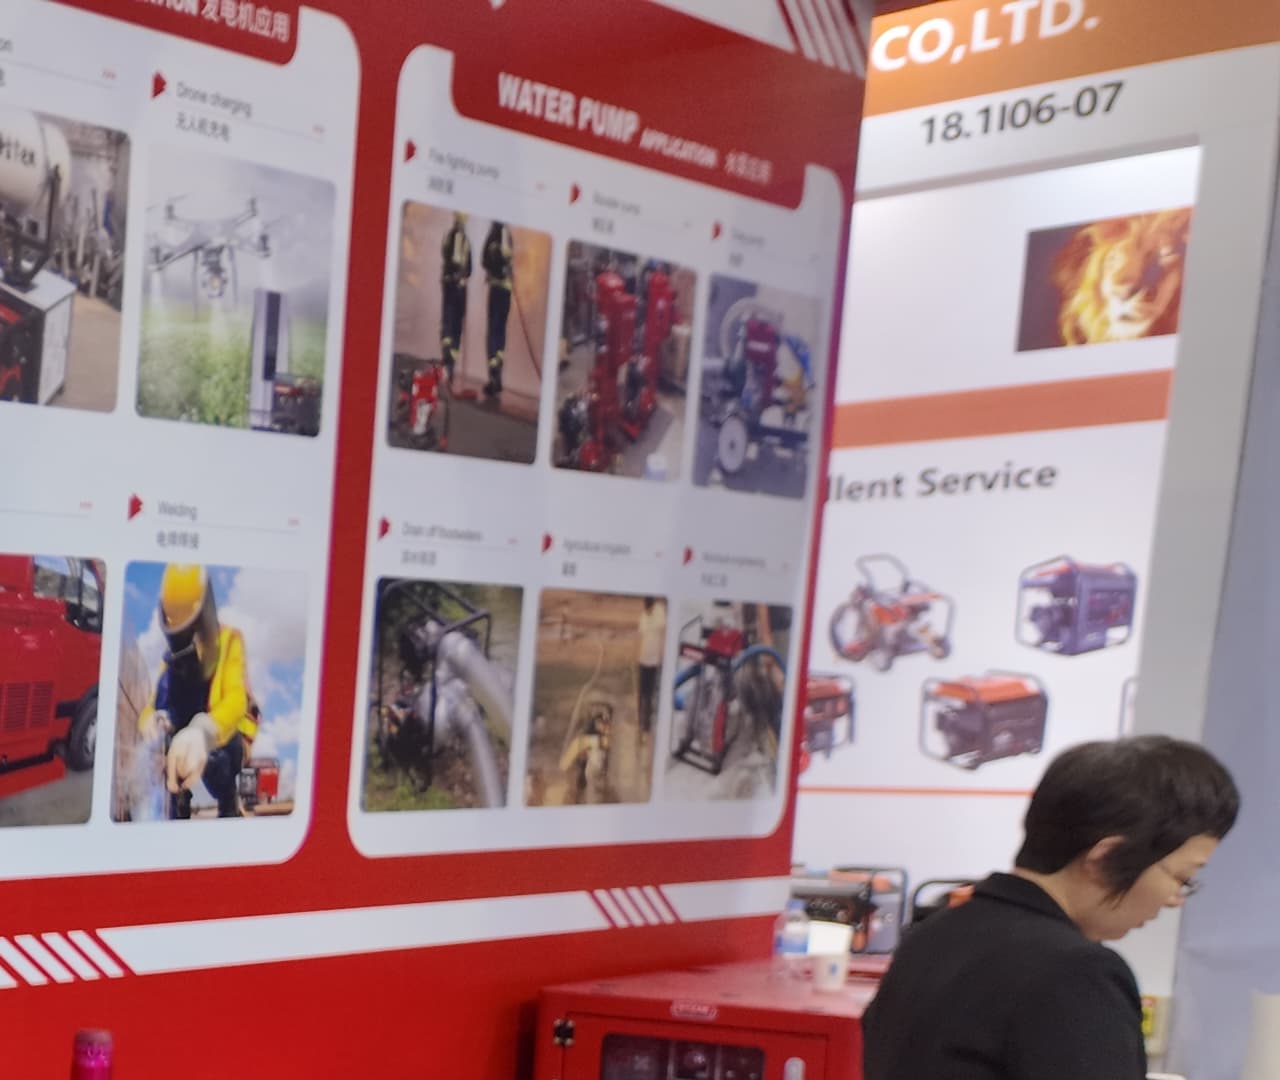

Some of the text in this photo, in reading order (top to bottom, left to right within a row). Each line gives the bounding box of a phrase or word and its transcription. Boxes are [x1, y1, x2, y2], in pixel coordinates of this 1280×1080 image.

[871, 0, 1101, 71] CO,LTD.
[498, 71, 576, 127] WATER
[578, 96, 639, 144] PUMP
[917, 461, 1058, 497] Service
